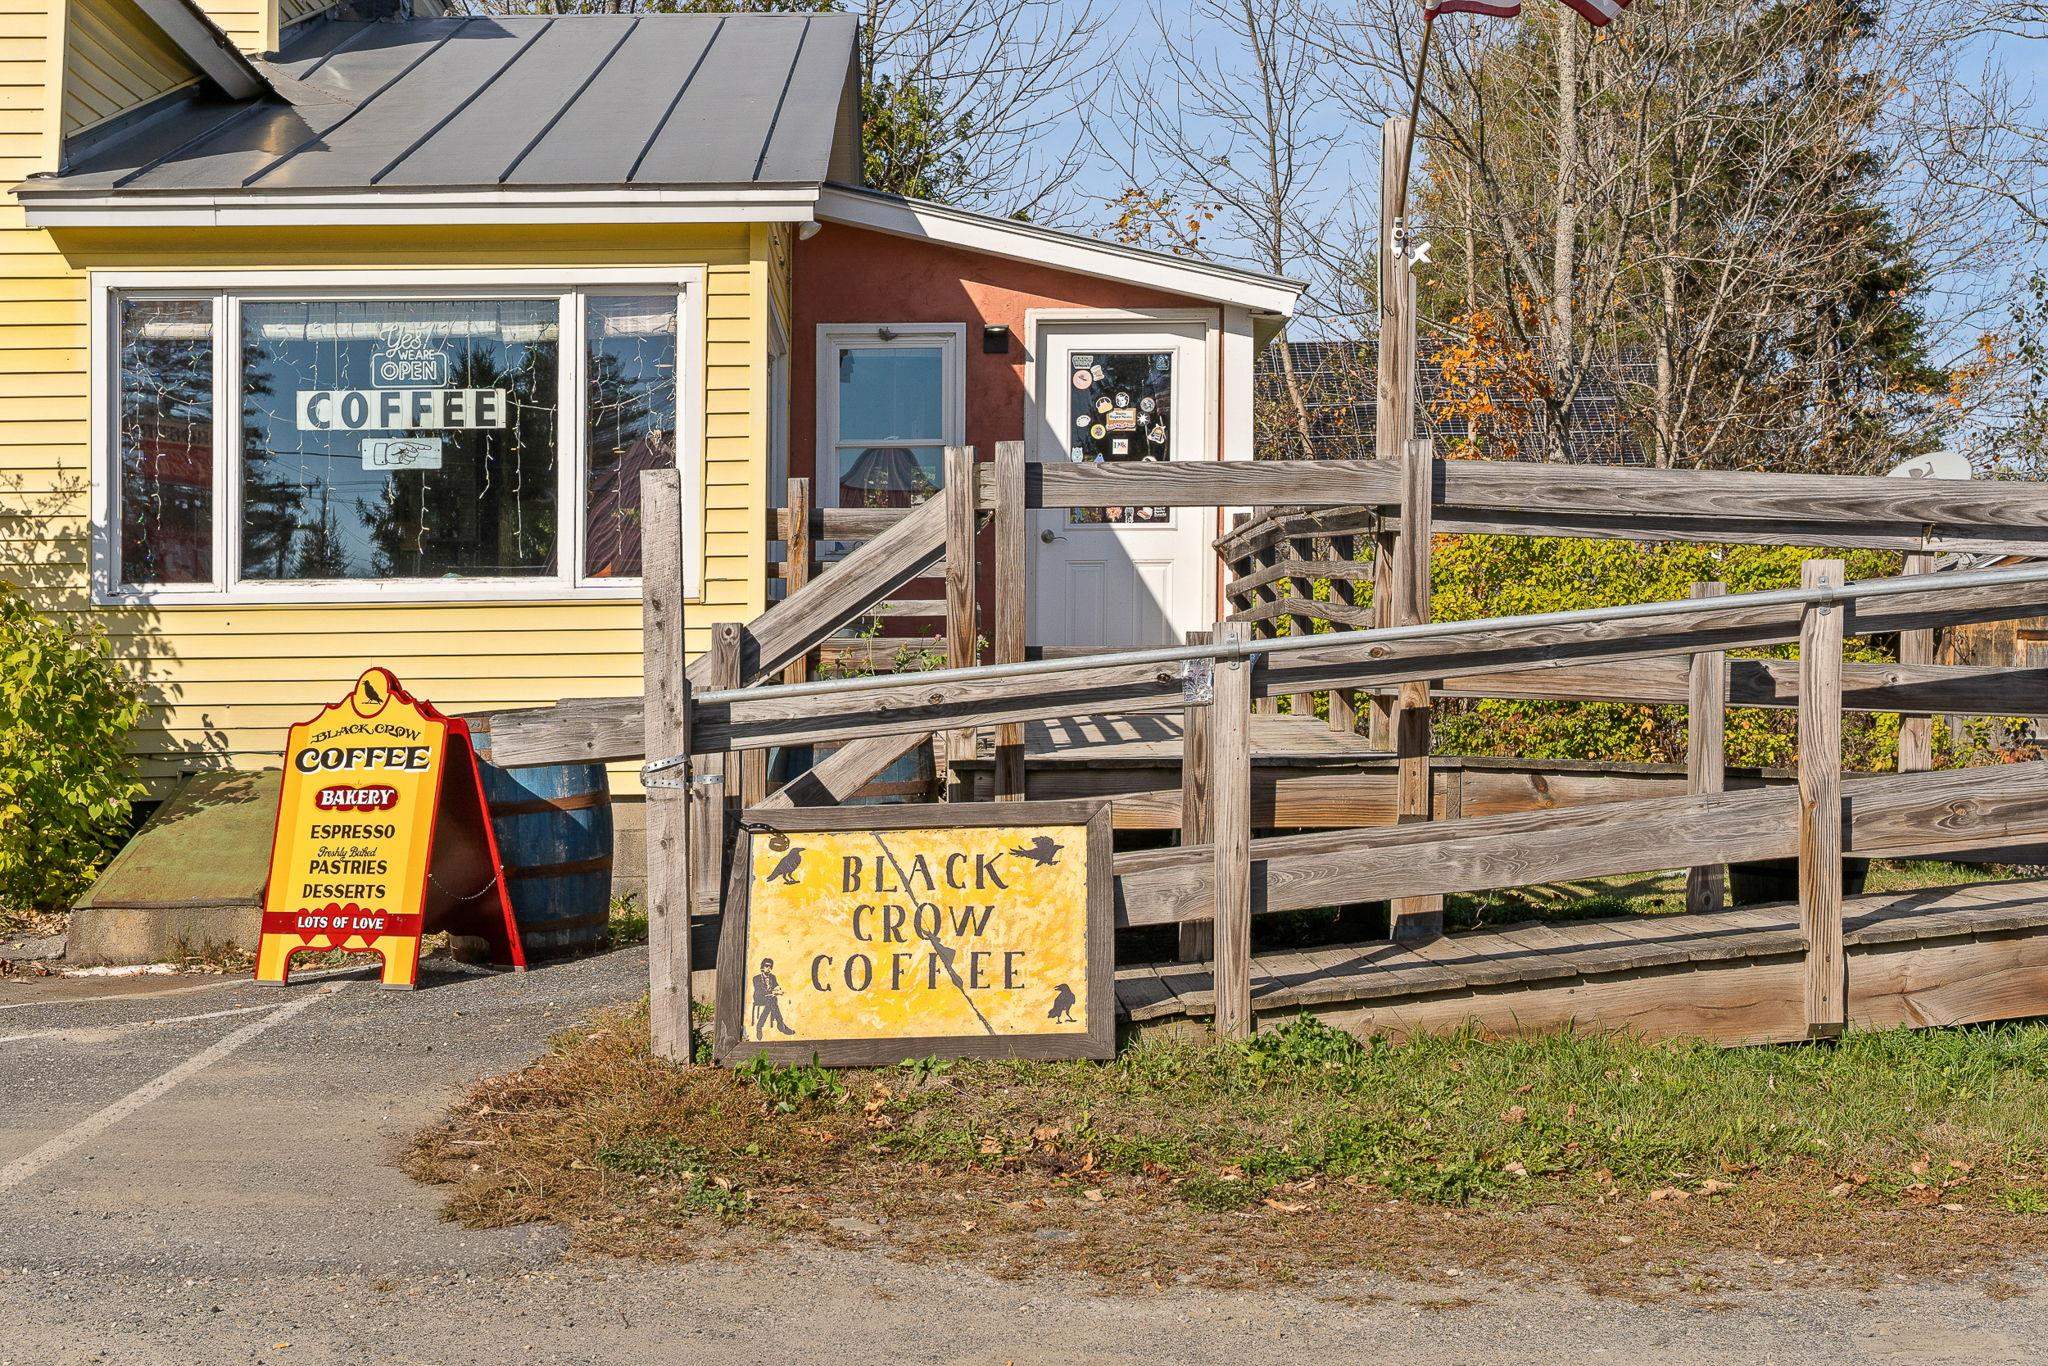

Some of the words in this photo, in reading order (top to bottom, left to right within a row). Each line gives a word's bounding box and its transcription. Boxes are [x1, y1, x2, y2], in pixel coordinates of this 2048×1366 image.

[380, 361, 437, 380] OPEN
[306, 391, 496, 429] COFFEE
[311, 724, 372, 743] BLACK
[374, 723, 421, 741] CROW
[295, 746, 431, 772] COFFEE
[321, 789, 394, 806] BAKERY
[310, 824, 396, 839] ESPRESSO
[317, 846, 347, 861] Freshly
[349, 846, 378, 858] Baked
[309, 860, 388, 875] PASTRIES
[842, 852, 1009, 893] BLACK
[302, 884, 386, 898] DESSERTS
[297, 916, 328, 929] LOTS
[332, 916, 349, 929] OF
[352, 917, 385, 930] LOVE
[852, 902, 996, 943] CROW
